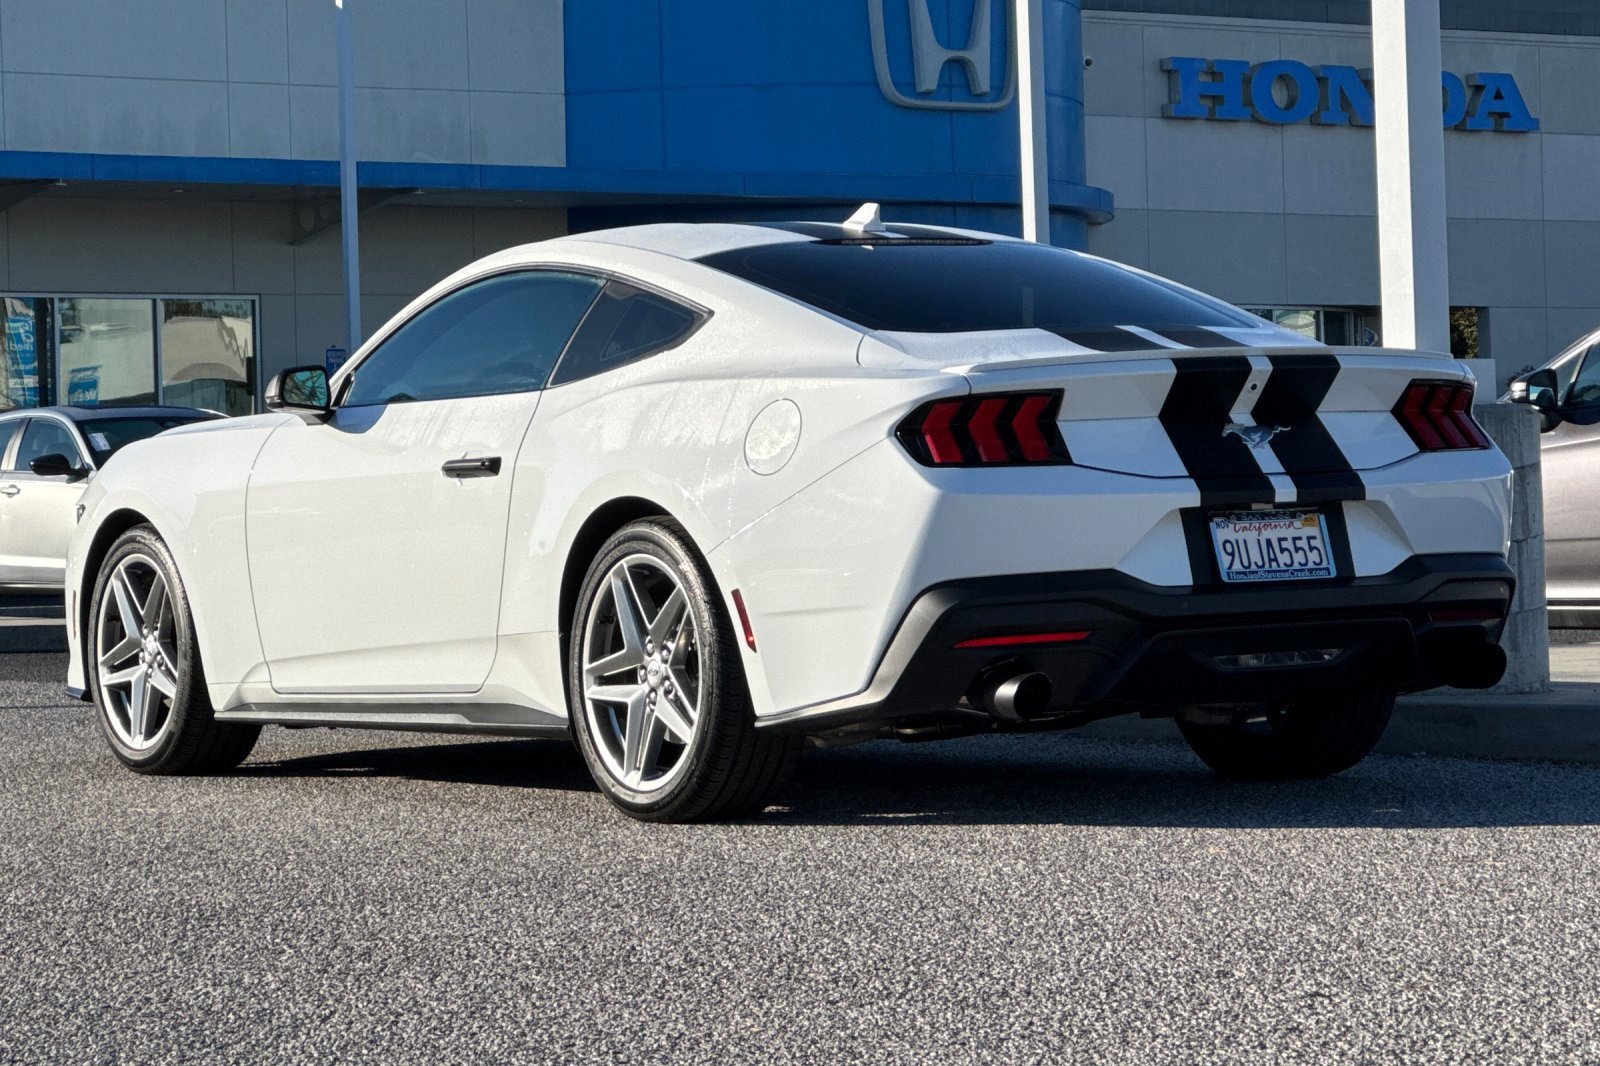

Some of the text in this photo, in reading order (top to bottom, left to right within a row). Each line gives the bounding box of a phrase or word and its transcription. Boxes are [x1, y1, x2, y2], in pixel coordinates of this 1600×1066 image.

[1215, 519, 1230, 530] NOV
[1233, 520, 1296, 537] California
[1222, 535, 1324, 570] 9UJA555
